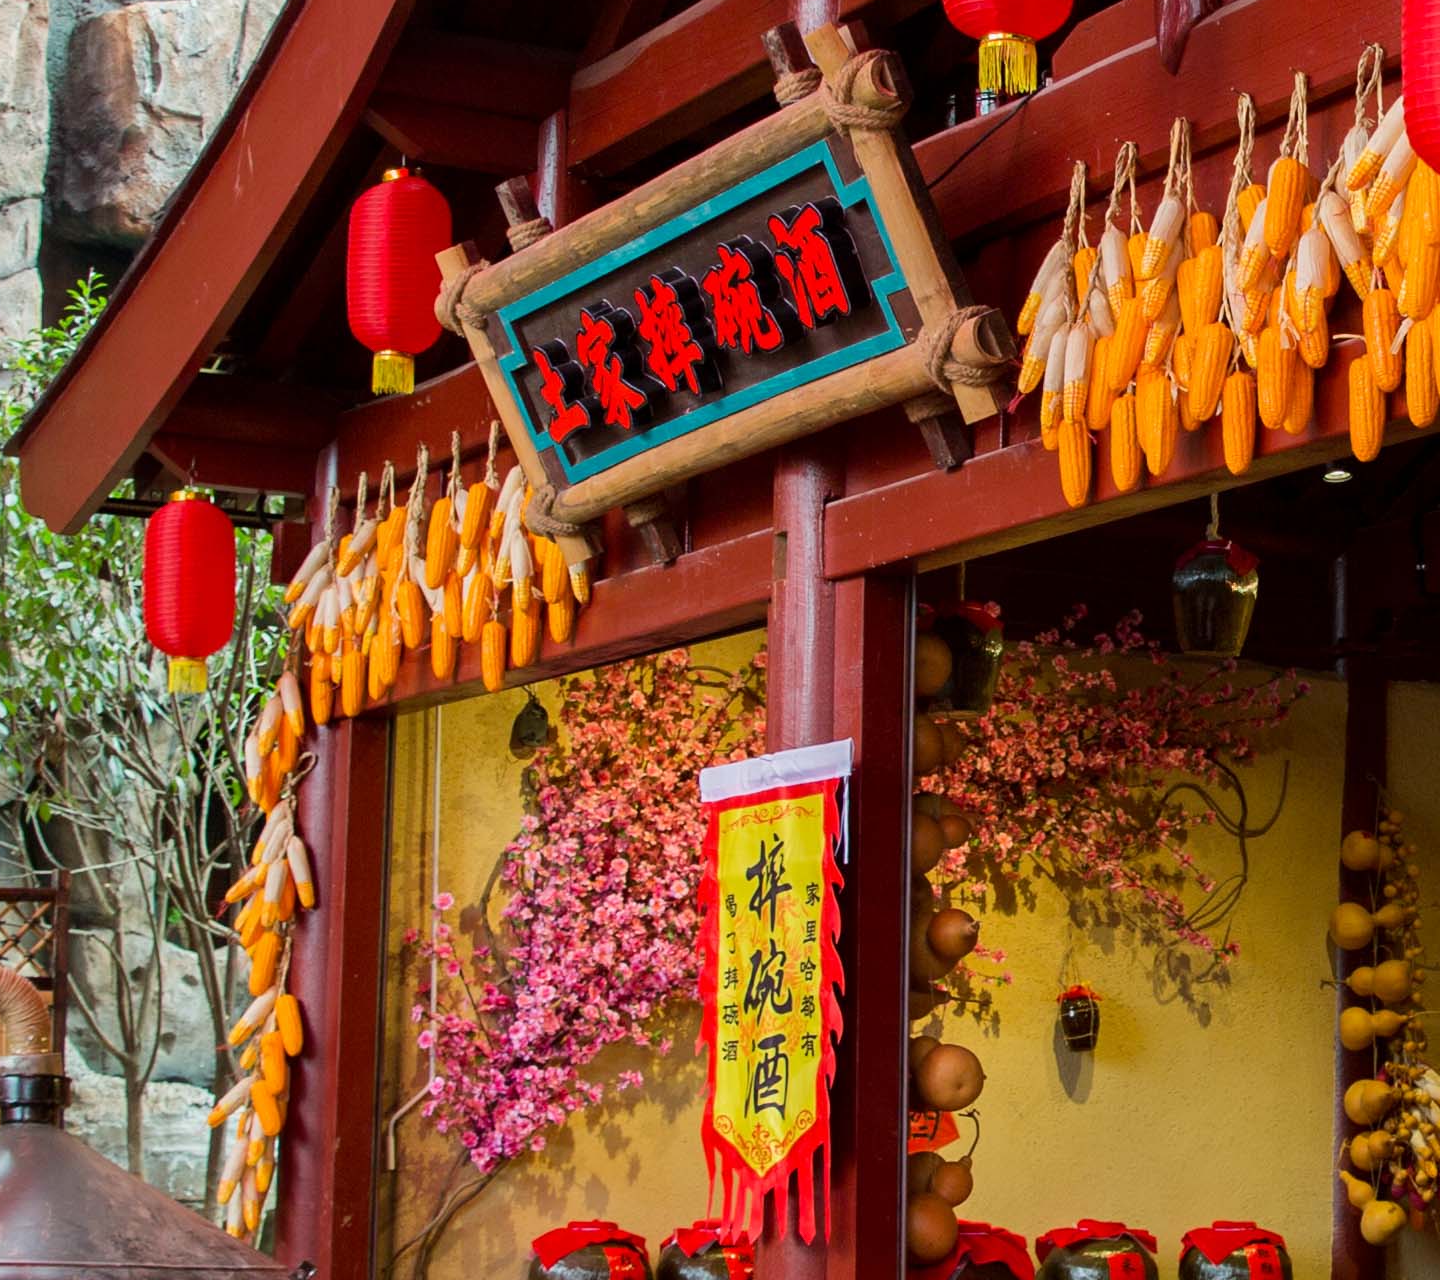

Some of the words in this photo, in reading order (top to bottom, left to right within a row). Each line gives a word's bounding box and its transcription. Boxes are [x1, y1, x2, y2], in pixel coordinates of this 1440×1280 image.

[533, 204, 851, 445] 土家摔碗酒
[722, 893, 740, 1063] 喝了摔碗酒
[742, 831, 793, 1121] 摔碗酒
